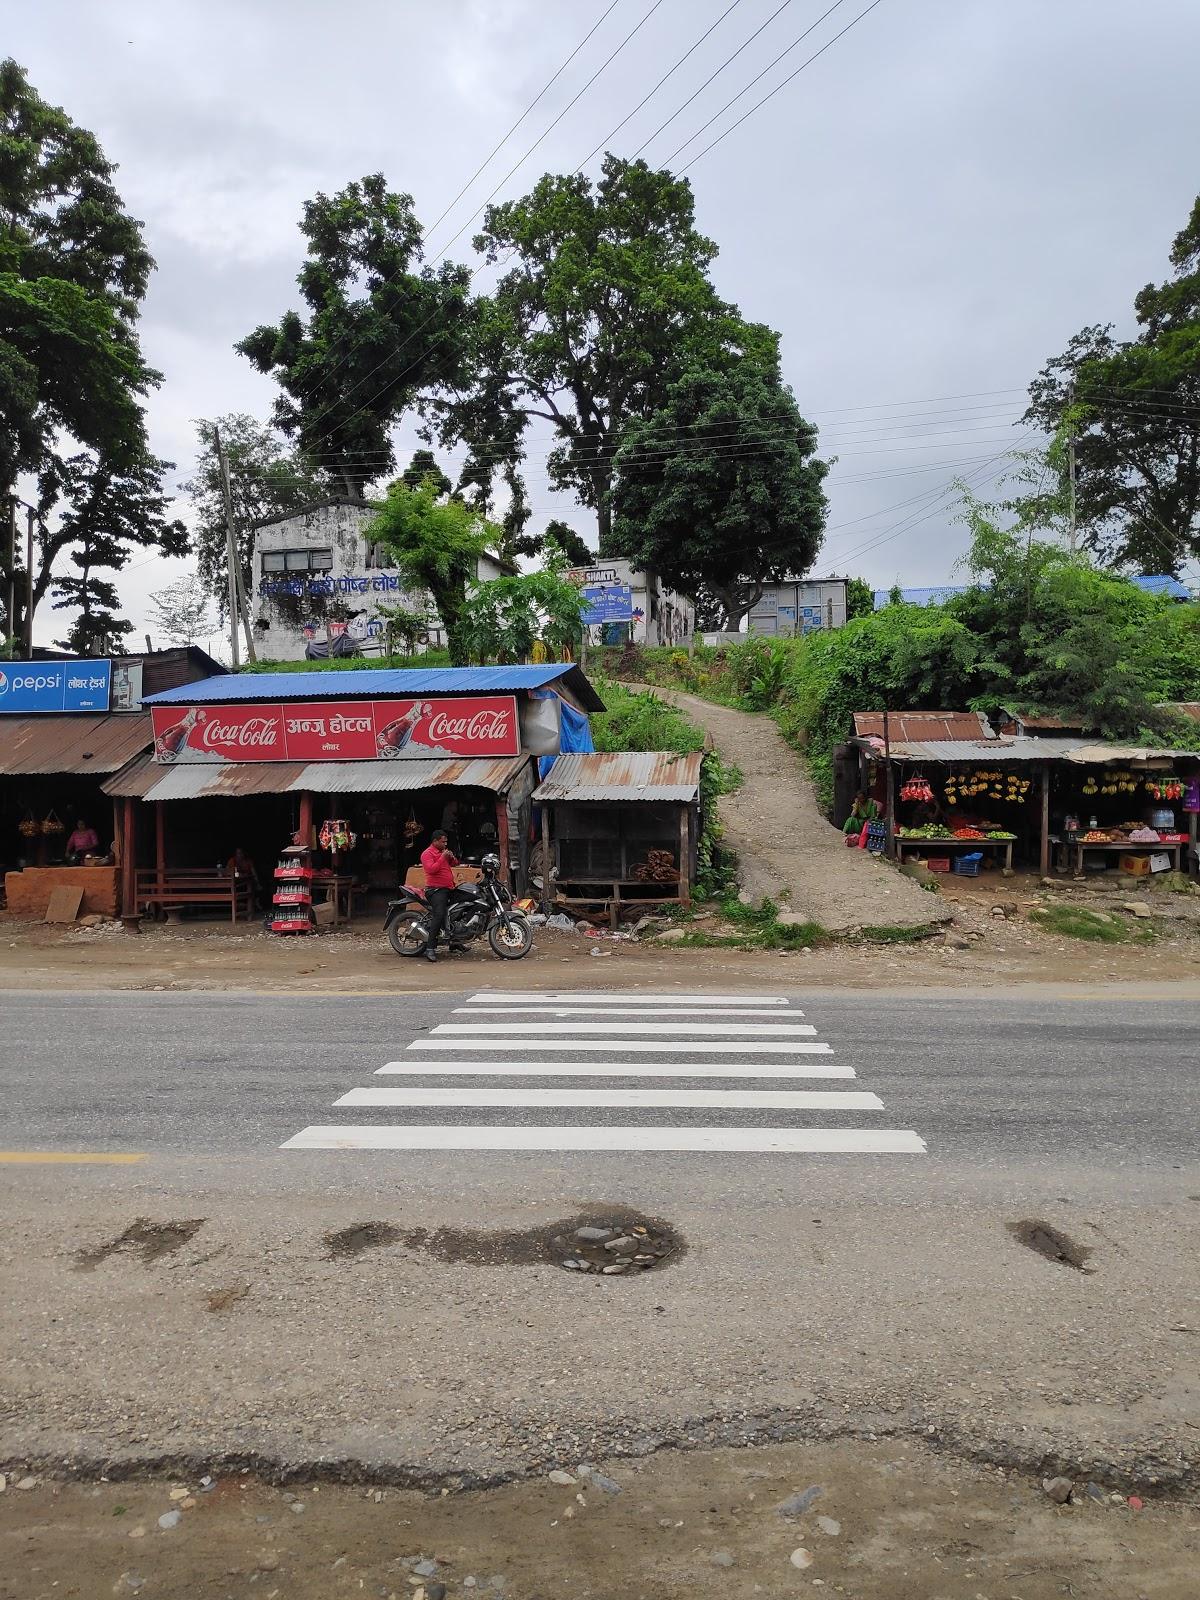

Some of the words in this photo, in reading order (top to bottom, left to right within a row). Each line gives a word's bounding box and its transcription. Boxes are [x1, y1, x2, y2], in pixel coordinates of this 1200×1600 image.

[371, 573, 402, 592] लोथ
[586, 571, 614, 582] SHAKTI
[12, 673, 61, 692] pepsi
[89, 676, 106, 691] ट्रेडर्स
[203, 717, 281, 747] Coca-Cola
[286, 718, 327, 737] अन्जु
[329, 713, 372, 734] होटल
[428, 709, 508, 742] Coca-Cola
